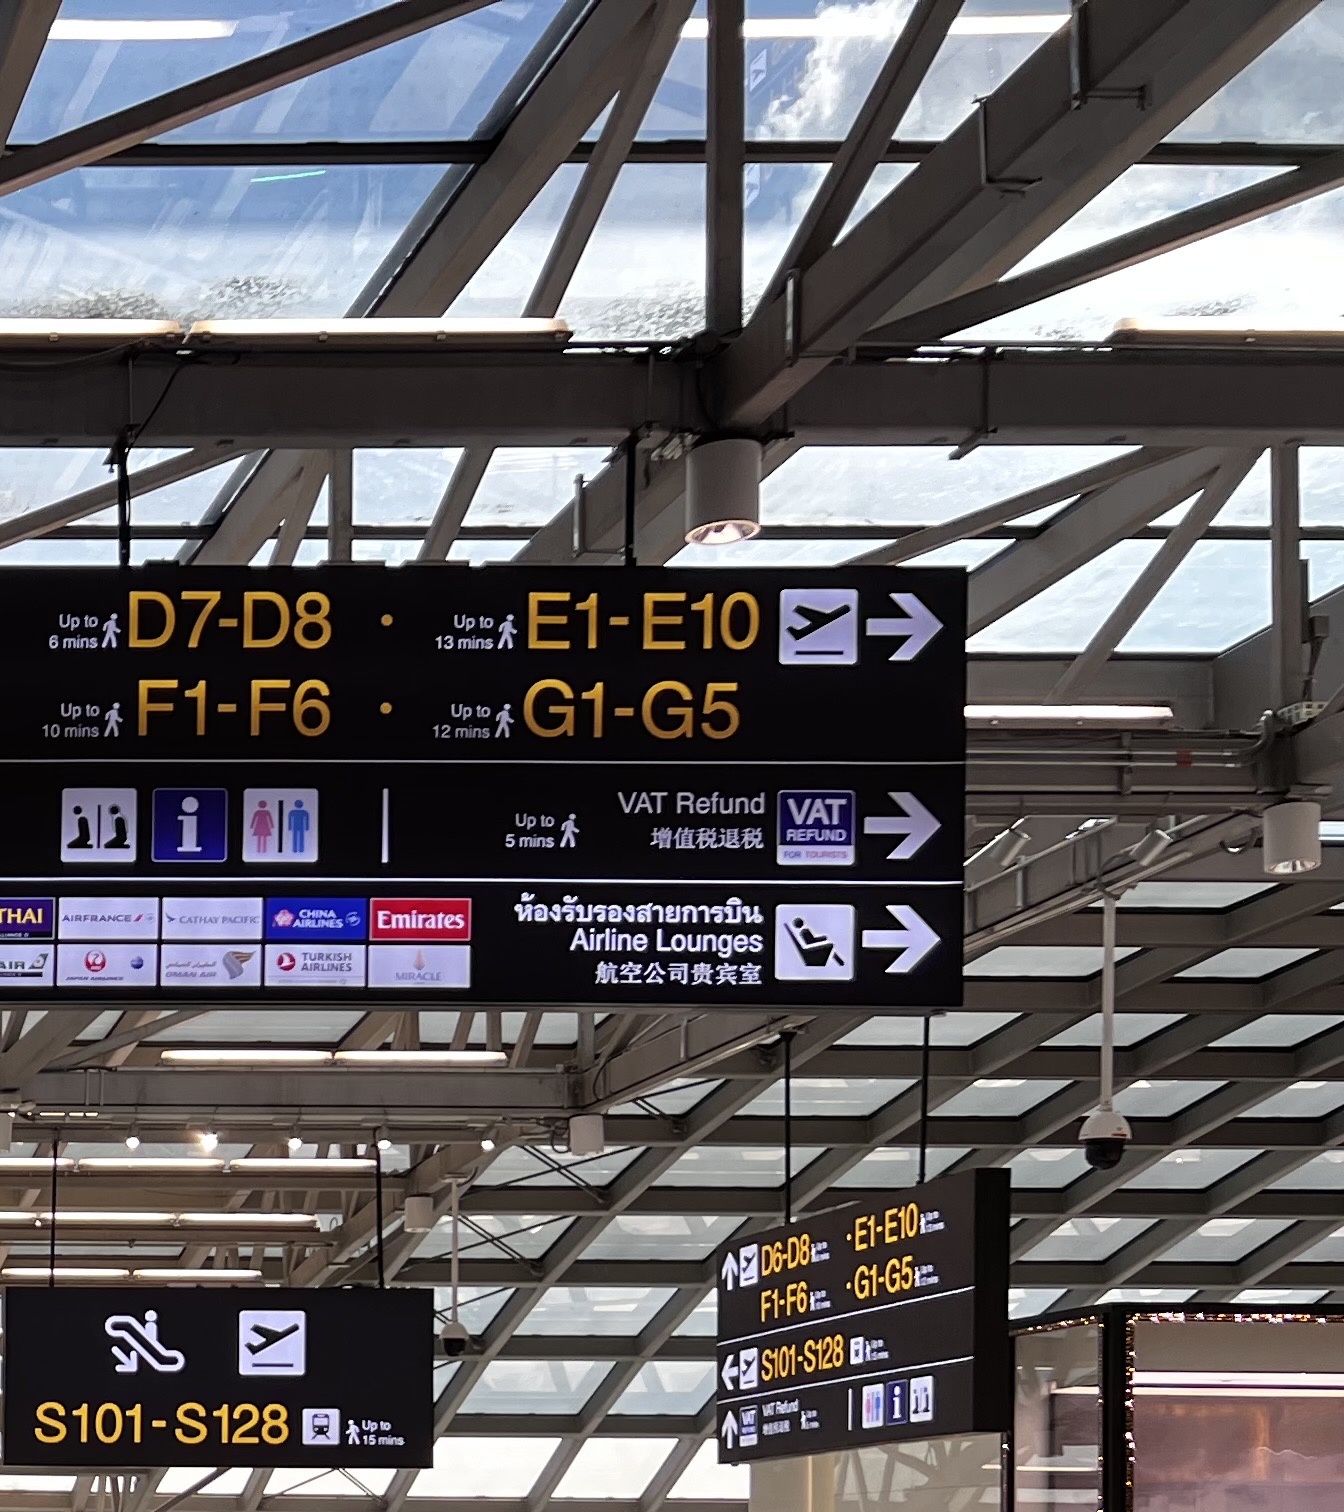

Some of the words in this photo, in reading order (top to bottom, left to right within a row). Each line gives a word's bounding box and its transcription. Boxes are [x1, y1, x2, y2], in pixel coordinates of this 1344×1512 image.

[60, 614, 80, 631] Up
[84, 615, 98, 627] to
[129, 591, 331, 649] D7-D8
[454, 614, 475, 631] Up
[480, 616, 493, 628] to
[528, 592, 759, 649] E1-E10
[49, 635, 58, 649] 6
[63, 635, 98, 648] mins
[435, 636, 454, 649] 13
[458, 636, 493, 649] mins
[61, 703, 81, 719] Up
[86, 704, 100, 716] to
[139, 680, 330, 736] F1-F6
[451, 704, 472, 720] Up
[476, 705, 490, 717] to
[524, 679, 739, 738] G1-G5
[42, 724, 60, 737] 10
[65, 724, 99, 737] mins
[433, 725, 451, 738] 12
[455, 725, 490, 738] mins
[618, 792, 668, 813] VAT
[677, 792, 764, 814] Refund
[787, 799, 847, 825] VAT
[516, 814, 536, 830] Up
[541, 815, 554, 827] to
[506, 834, 515, 847] 5
[519, 834, 554, 848] mins
[650, 827, 764, 849] 增值税退税
[786, 829, 846, 841] REFUND
[298, 908, 337, 919] CHINA
[514, 892, 764, 923] ห้องรับรองสายการบิน
[179, 915, 219, 924] CATHAY
[221, 915, 260, 924] PACIFIC
[292, 918, 344, 929] AIRLINES
[377, 909, 465, 930] Emirates
[570, 928, 648, 951] Airline
[657, 929, 763, 958] Lounges
[301, 952, 353, 961] TURKISH
[301, 962, 353, 972] AIRLINES
[595, 961, 762, 985] 航空公司贵宾室
[395, 971, 443, 981] MIRACLE
[854, 1203, 919, 1251] E1-E10
[762, 1234, 809, 1276] D6-D8
[854, 1255, 914, 1299] G1-G5
[761, 1281, 807, 1322] F1-F6
[761, 1334, 844, 1382] S101-S128
[35, 1402, 288, 1444] S101-S128
[361, 1419, 378, 1433] Up
[380, 1420, 392, 1431] to
[363, 1434, 377, 1446] 15
[378, 1434, 405, 1446] mins
